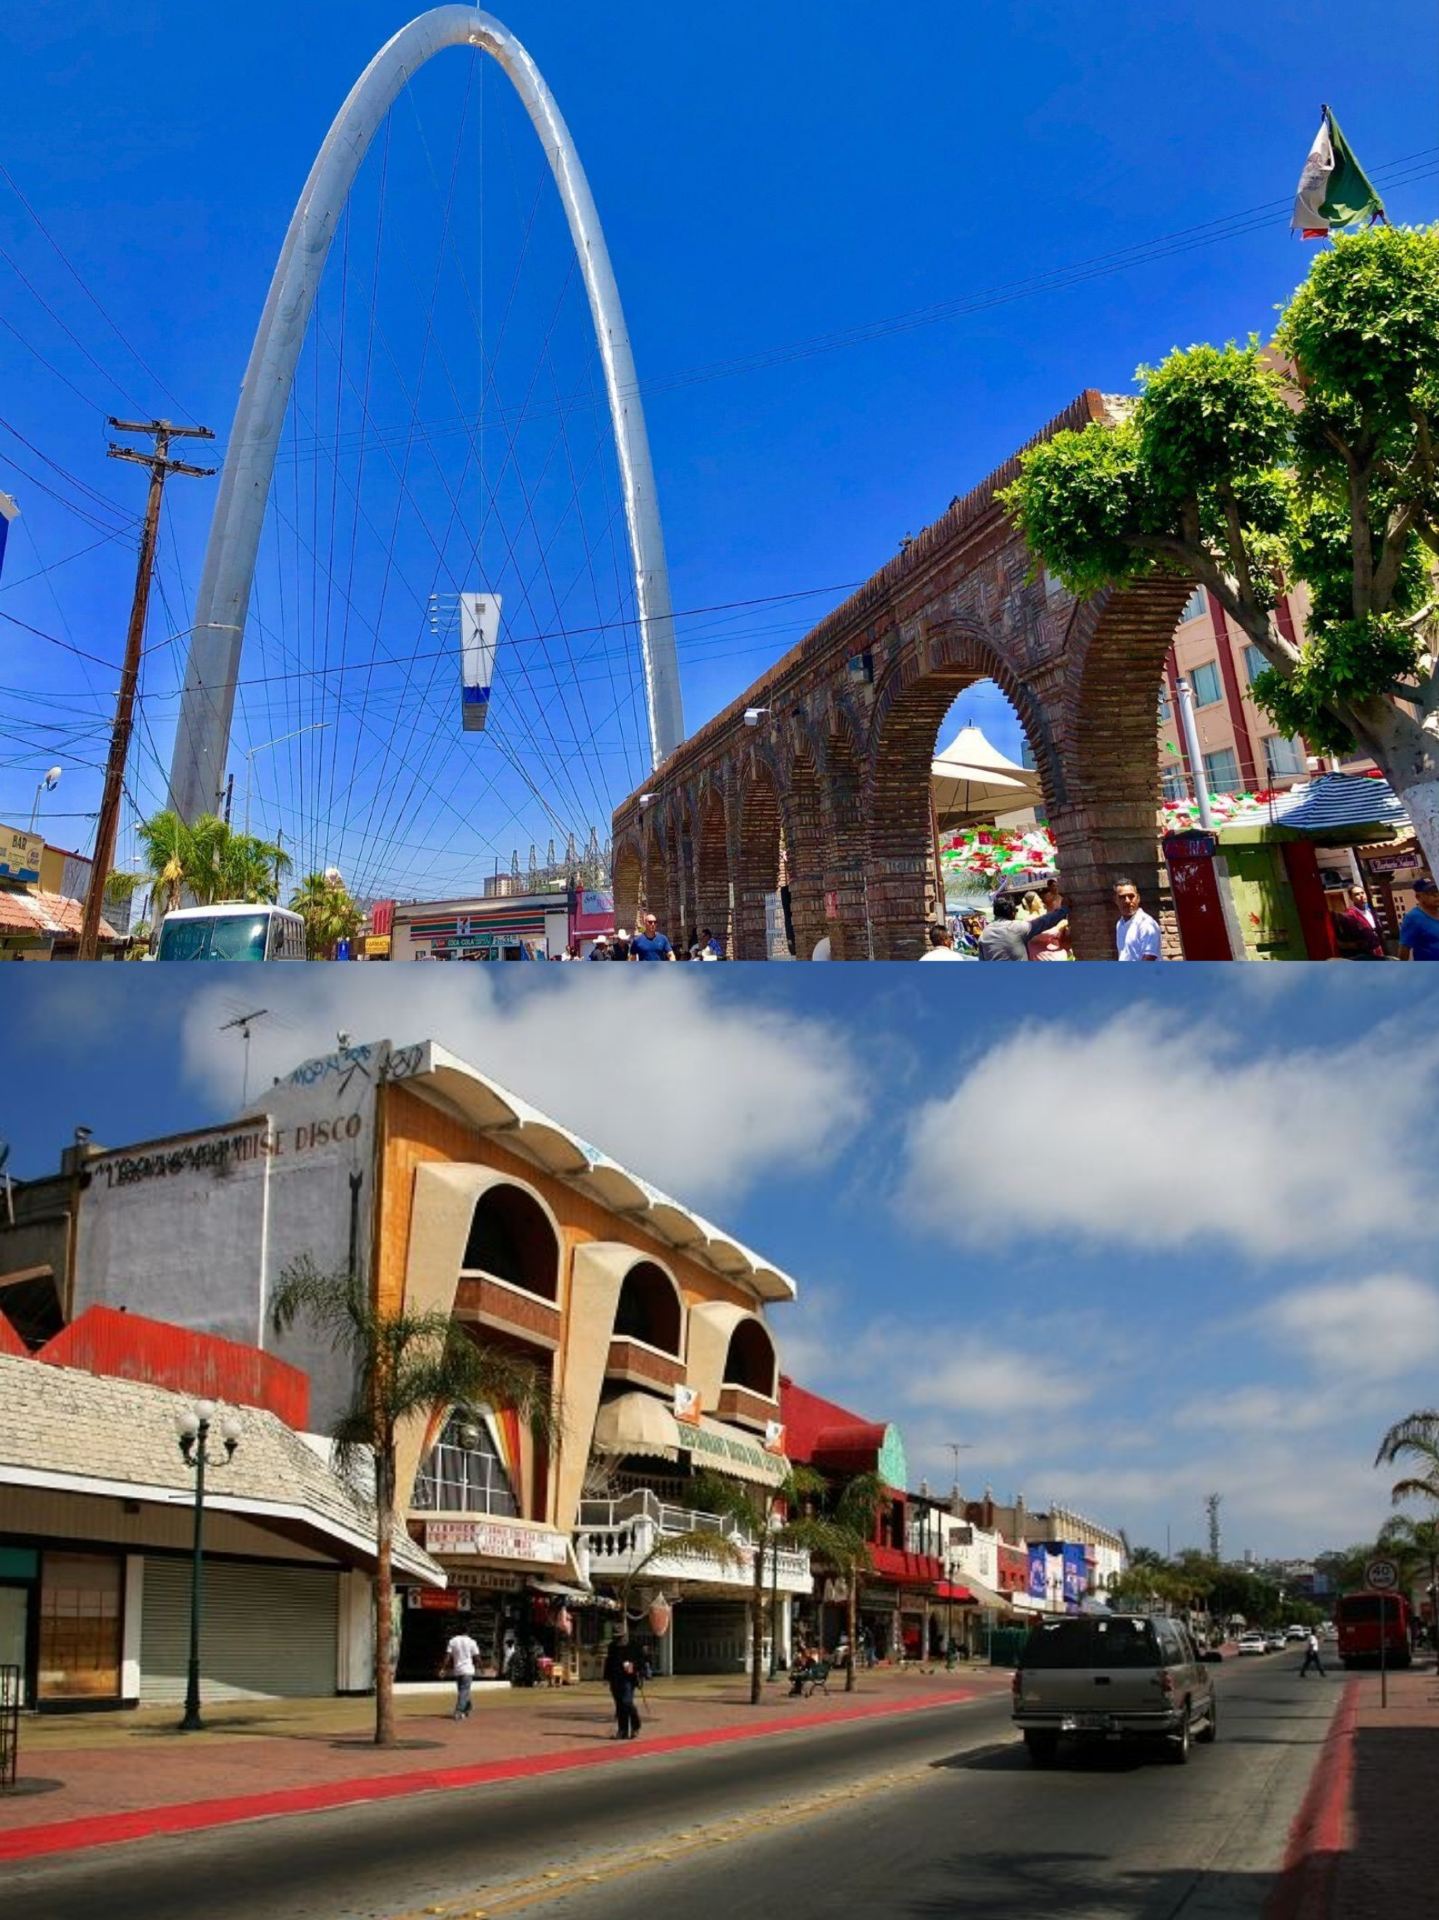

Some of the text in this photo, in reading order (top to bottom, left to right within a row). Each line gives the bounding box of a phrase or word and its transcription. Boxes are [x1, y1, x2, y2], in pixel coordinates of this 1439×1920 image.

[12, 835, 28, 850] BAR
[295, 1113, 362, 1150] DISCO
[1372, 1566, 1391, 1577] 40
